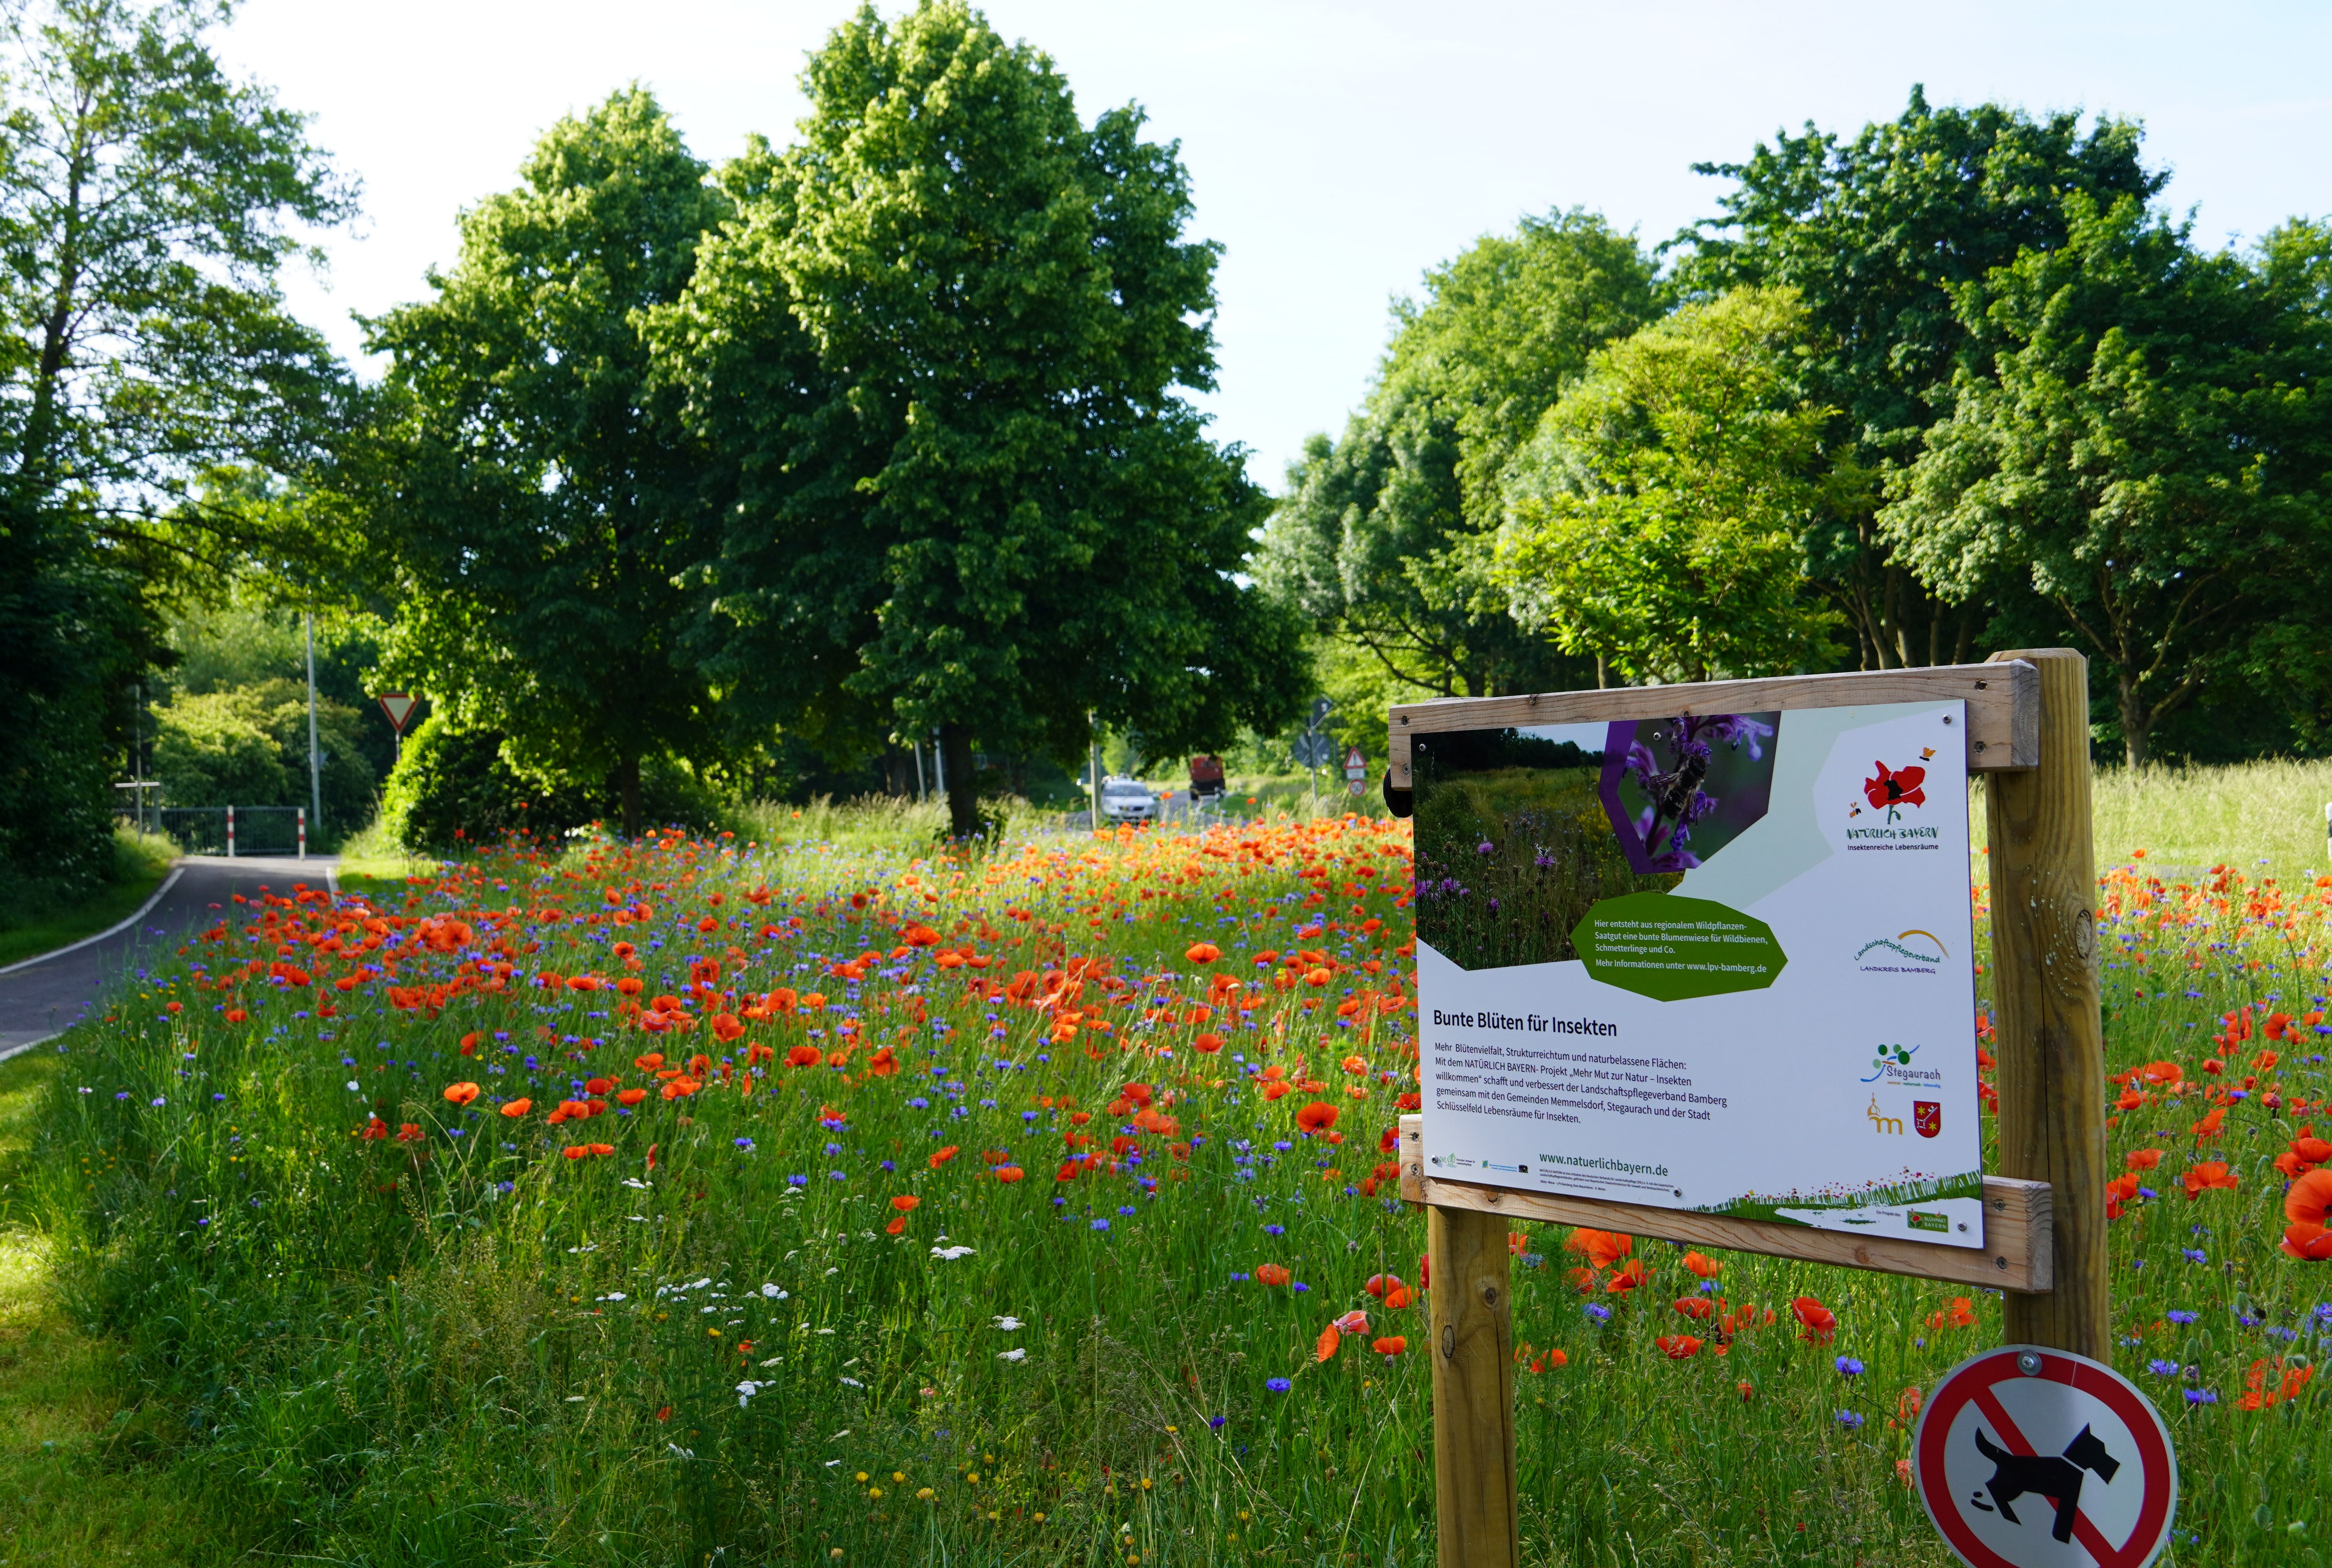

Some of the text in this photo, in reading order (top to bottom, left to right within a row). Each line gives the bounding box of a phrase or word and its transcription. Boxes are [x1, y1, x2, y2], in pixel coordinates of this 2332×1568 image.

[1846, 827, 1938, 839] NATÜRLICH BAYERN
[1654, 921, 1694, 930] regionalem
[1696, 921, 1747, 930] Wildpflanzen-
[1595, 932, 1621, 941] Saatgut
[1639, 932, 1659, 941] bunte
[1661, 933, 1709, 942] Blumenwiese
[1711, 934, 1721, 942] für
[1723, 935, 1767, 945] Wildbienen,
[1596, 944, 1647, 954] Schmetterlinge
[1854, 939, 1940, 963] Landschaftspflegeverband
[1614, 959, 1664, 969] Informationen
[1687, 963, 1767, 974] www.lpv-bamberg.de
[1434, 1010, 1617, 1036] Bunte Blüten für Insekten
[1435, 1043, 1686, 1070] Mehr Blütenvielfalt, Strukturreichtum und naturbelassene Flächen:
[1436, 1057, 1446, 1065] Mit
[1448, 1058, 1463, 1067] dem
[1465, 1059, 1505, 1070] NATÜRLICH
[1507, 1063, 1538, 1073] BAYERN-
[1541, 1065, 1567, 1077] Projekt
[1570, 1068, 1592, 1078] „Mehr
[1594, 1070, 1609, 1079] Mut
[1625, 1072, 1648, 1082] Natur
[1657, 1075, 1692, 1086] Insekten
[1887, 1065, 1940, 1080] Stegaurach
[1436, 1072, 1727, 1108] willkommen“ schafft und verbessert der Landschaftspflegeverband Bamberg
[1436, 1087, 1710, 1120] gemeinsam mit den Gemeinden Memmelsdorf, Stegaurach und der Stadt
[1437, 1101, 1581, 1123] Schlüsselfeld Lebensräume für Insekten.
[1539, 1154, 1668, 1176] www.natuerlichbayern.de
